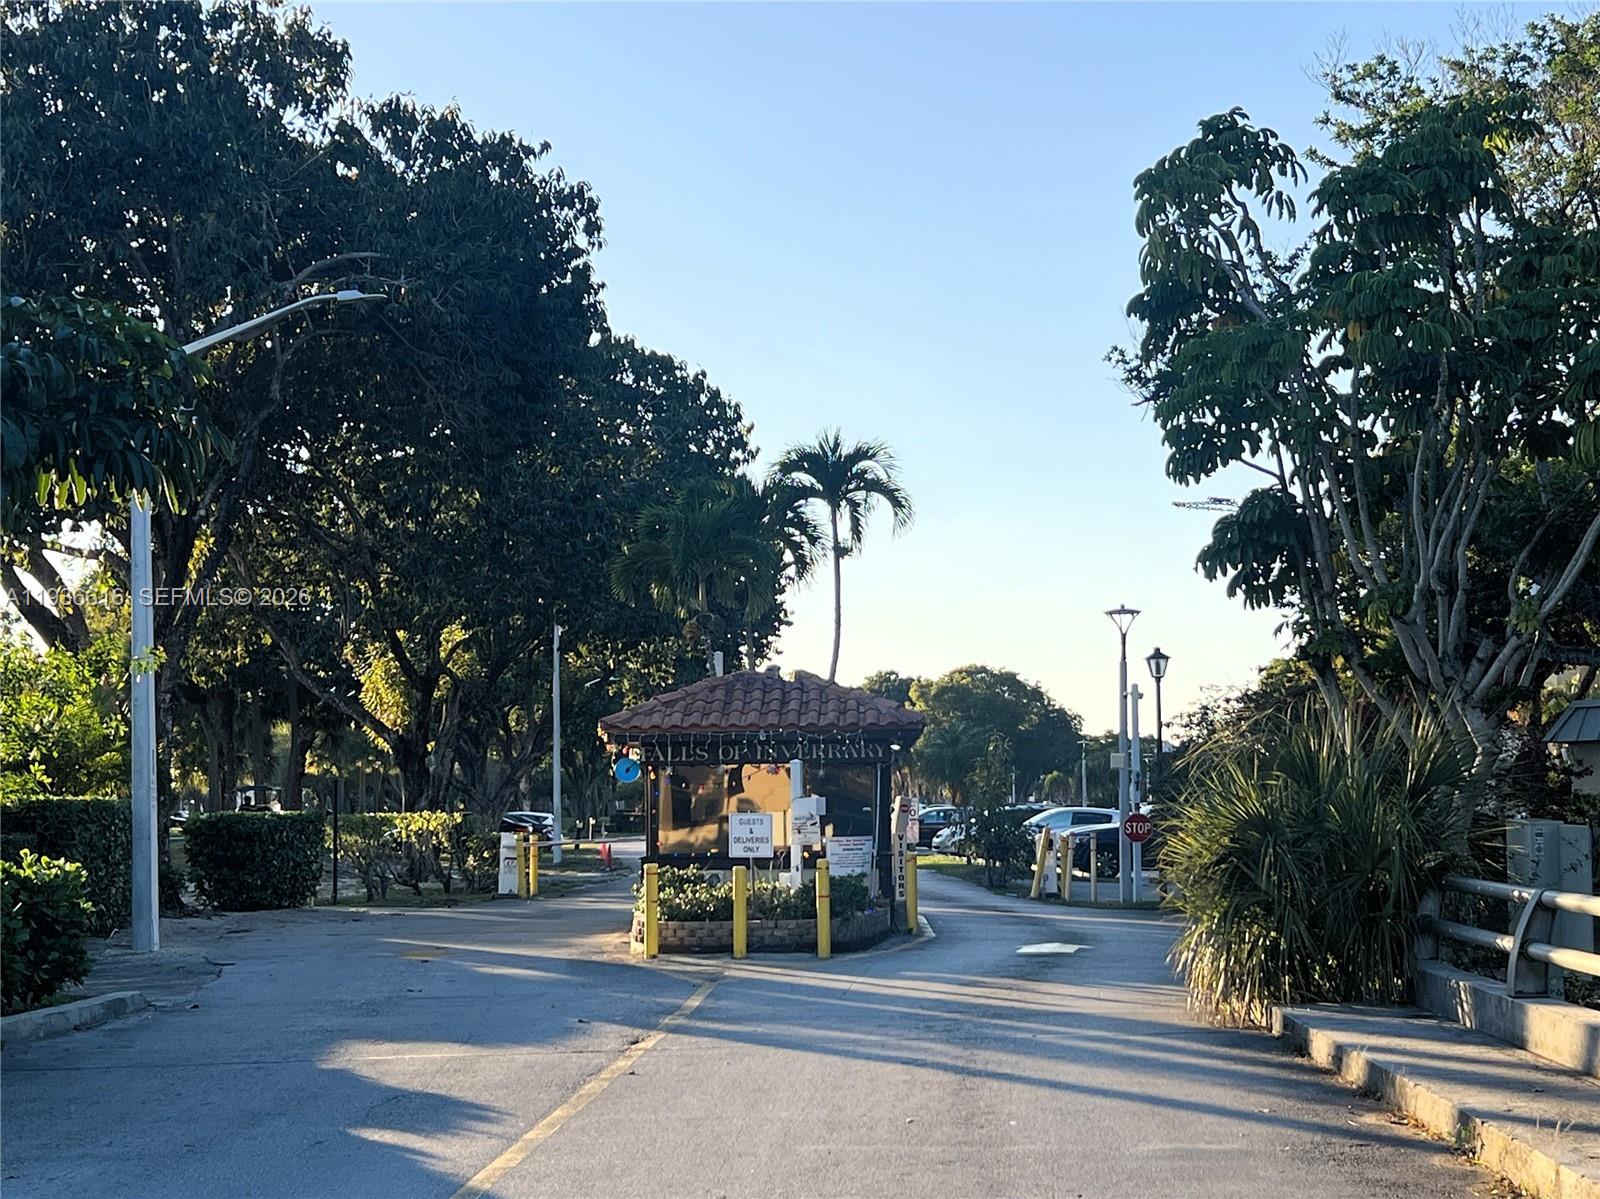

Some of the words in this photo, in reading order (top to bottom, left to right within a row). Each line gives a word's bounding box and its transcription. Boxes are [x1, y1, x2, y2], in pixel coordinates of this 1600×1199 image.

[640, 745, 709, 761] FALLS
[719, 744, 748, 761] OF
[755, 743, 884, 760] INVERRARY
[738, 817, 764, 826] GUESTS
[1125, 822, 1152, 834] STOP
[733, 836, 770, 844] DELIVERIES
[742, 845, 760, 853] ONLY
[897, 834, 905, 898] VISITORS
